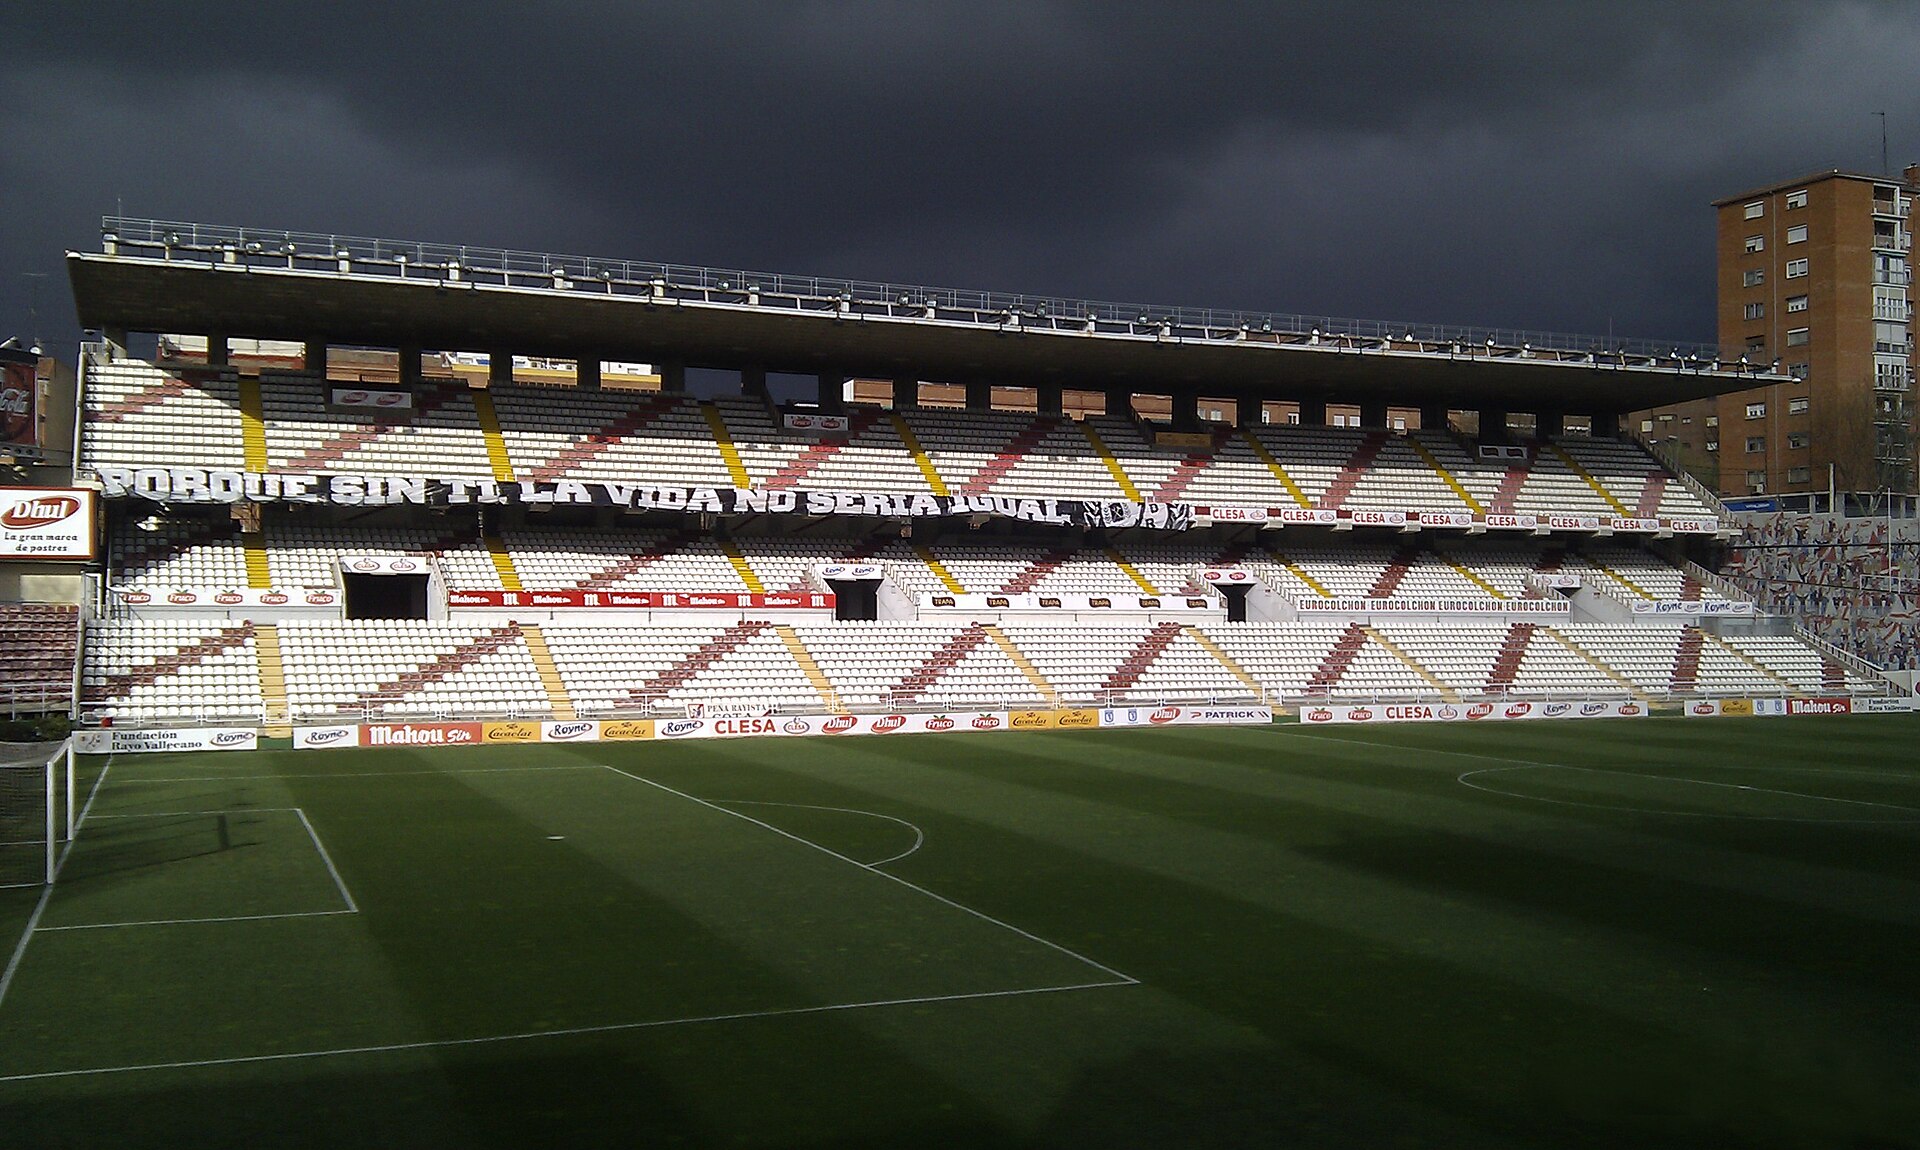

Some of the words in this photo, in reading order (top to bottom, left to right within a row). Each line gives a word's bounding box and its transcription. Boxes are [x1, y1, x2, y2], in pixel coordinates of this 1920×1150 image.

[330, 475, 426, 504] SIN
[521, 481, 592, 504] LA
[603, 484, 723, 513] VIDA
[733, 488, 797, 513] NO
[806, 491, 940, 516] SERIA
[950, 495, 1072, 526] IGUAL
[11, 500, 69, 518] Dhul
[1212, 508, 1246, 519] CLESA
[1283, 510, 1316, 521] CLESA
[1354, 512, 1386, 523] CLESA
[1421, 514, 1452, 525] CLESA
[1488, 515, 1517, 526] CLESA
[1551, 517, 1580, 528] CLESA
[1613, 519, 1641, 530] CLESA
[1672, 520, 1700, 531] CLESA
[4, 532, 17, 540] La
[19, 534, 43, 542] gran
[15, 544, 28, 552] de
[30, 544, 67, 552] postres
[169, 593, 196, 603] Fruco
[215, 594, 243, 603] Fruco
[261, 594, 288, 603] Fruco
[306, 594, 333, 603] Fruco
[1300, 600, 1366, 610] EUROCOLCHON
[1371, 600, 1436, 610] EUROCOLCHON
[1439, 600, 1505, 611] EUROCOLCHON
[1506, 600, 1568, 611] EUROCOLCHON
[731, 704, 767, 712] RAYISTA
[1791, 699, 1831, 714] Mahou
[1154, 708, 1176, 719] Dhul
[1205, 711, 1254, 719] PATRICK
[1309, 711, 1332, 720] Fruco
[1350, 711, 1373, 720] Fruco
[1386, 706, 1433, 719] CLESA
[667, 721, 699, 733] Royne
[715, 719, 776, 734] CLESA
[827, 716, 853, 729] Dhul
[877, 716, 901, 728] Dhul
[927, 719, 953, 729] Fruco
[974, 718, 999, 727] Fruco
[369, 725, 445, 745] Mahou
[447, 730, 472, 743] Sin
[554, 723, 586, 736] Royne
[112, 731, 178, 741] Fundación
[112, 741, 142, 752] Rayo
[144, 740, 203, 751] Vallecano
